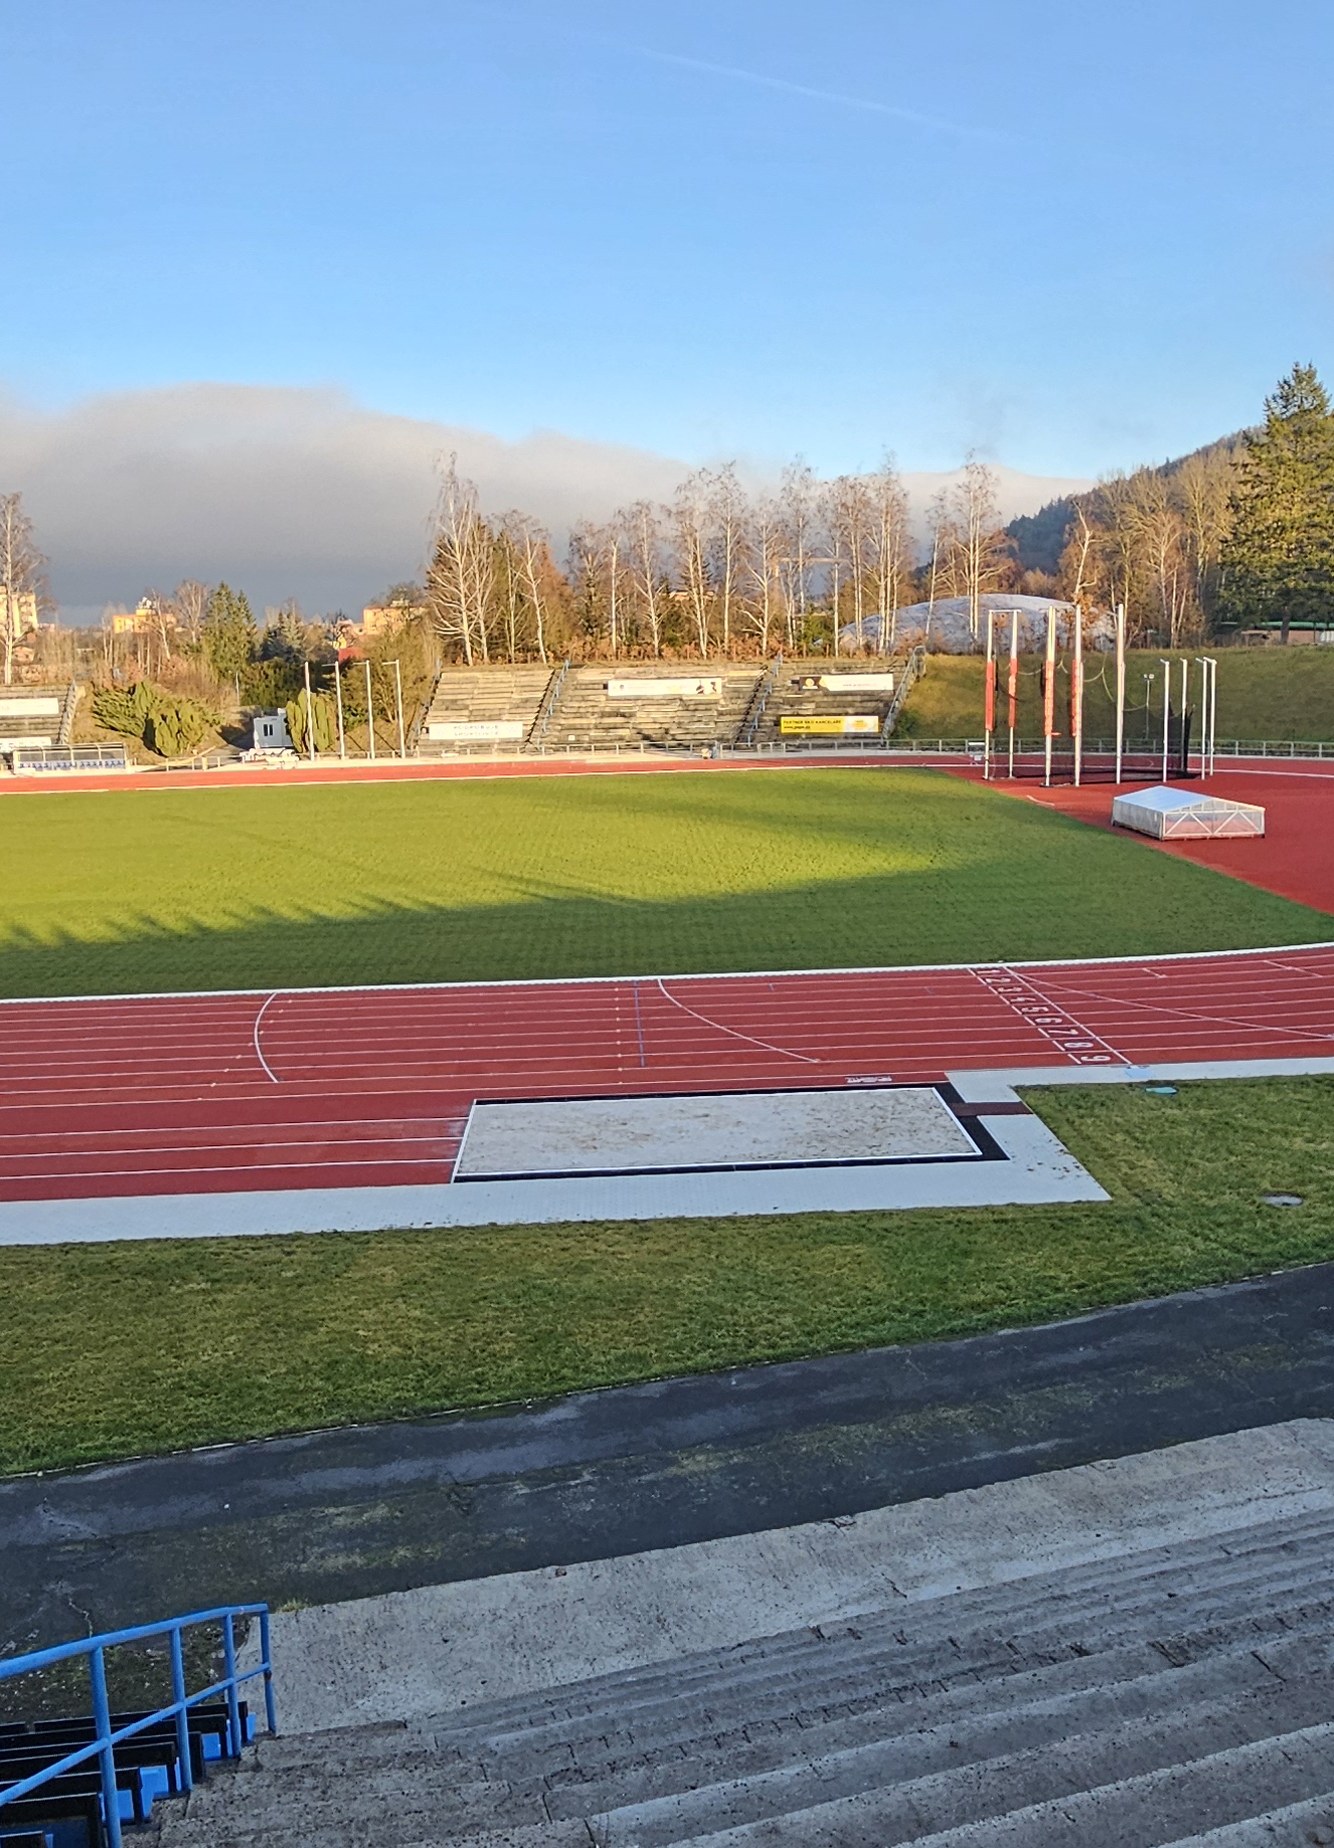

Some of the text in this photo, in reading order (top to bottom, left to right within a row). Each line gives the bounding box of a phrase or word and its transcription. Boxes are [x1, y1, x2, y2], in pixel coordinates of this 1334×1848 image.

[1047, 1028, 1079, 1036] 7
[1063, 1041, 1094, 1049] 8
[1080, 1055, 1111, 1063] 9
